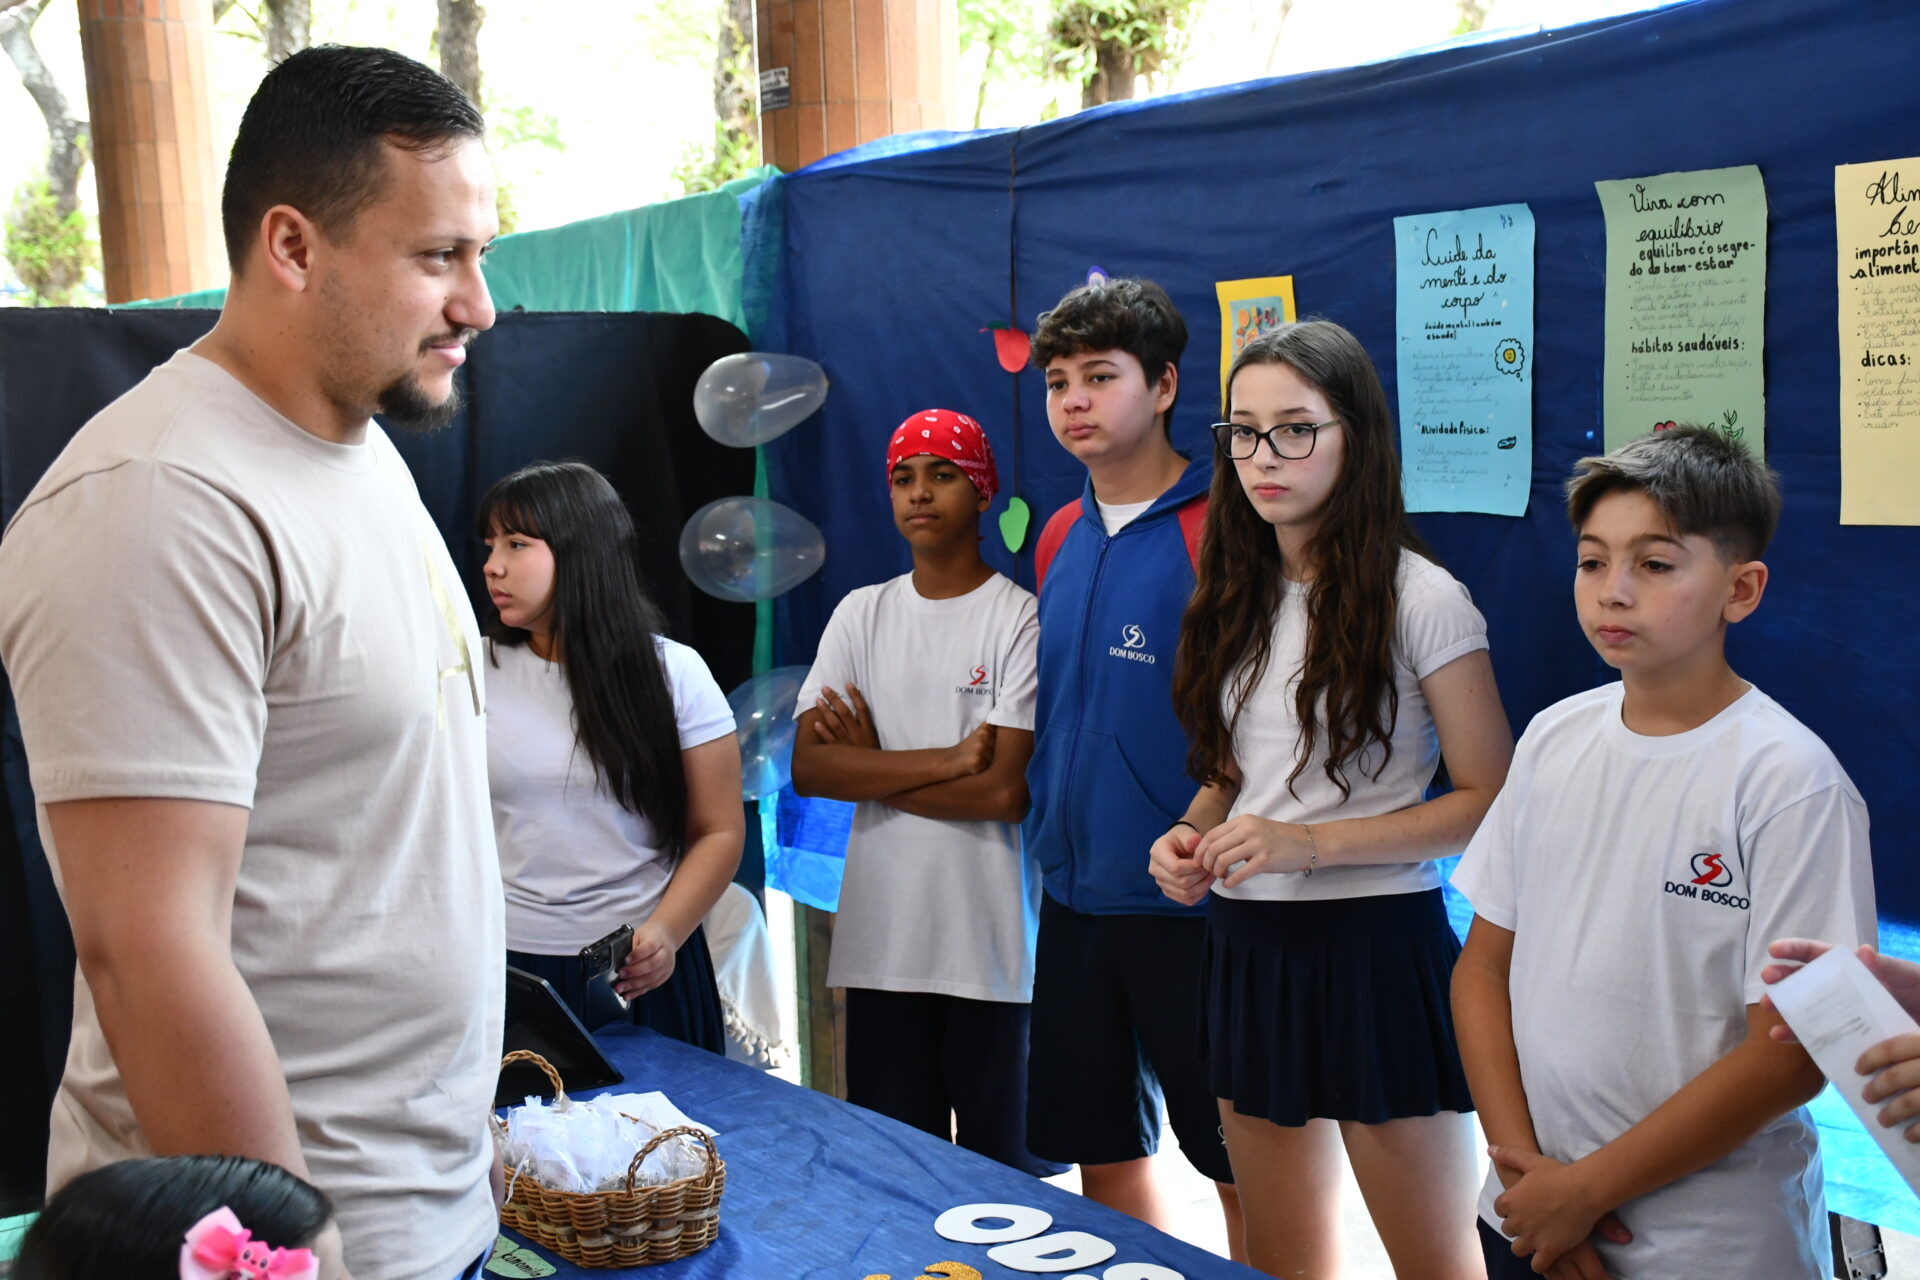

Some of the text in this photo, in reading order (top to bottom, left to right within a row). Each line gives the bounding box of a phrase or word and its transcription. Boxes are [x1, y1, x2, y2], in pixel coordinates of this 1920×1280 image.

[1629, 184, 1725, 213] Viva com
[1636, 216, 1724, 252] equilíbrio
[1421, 228, 1496, 266] Cuide da
[1717, 241, 1756, 258] segre-
[1420, 264, 1507, 289] mente e do
[1629, 262, 1643, 276] do
[1441, 292, 1485, 319] corpo
[1631, 333, 1745, 354] hábitos saudáveis:
[1861, 350, 1911, 367] dicas:
[1109, 646, 1155, 665] DOM BOSCO
[955, 686, 973, 695] DOM
[1664, 881, 1750, 910] DOM BOSCO
